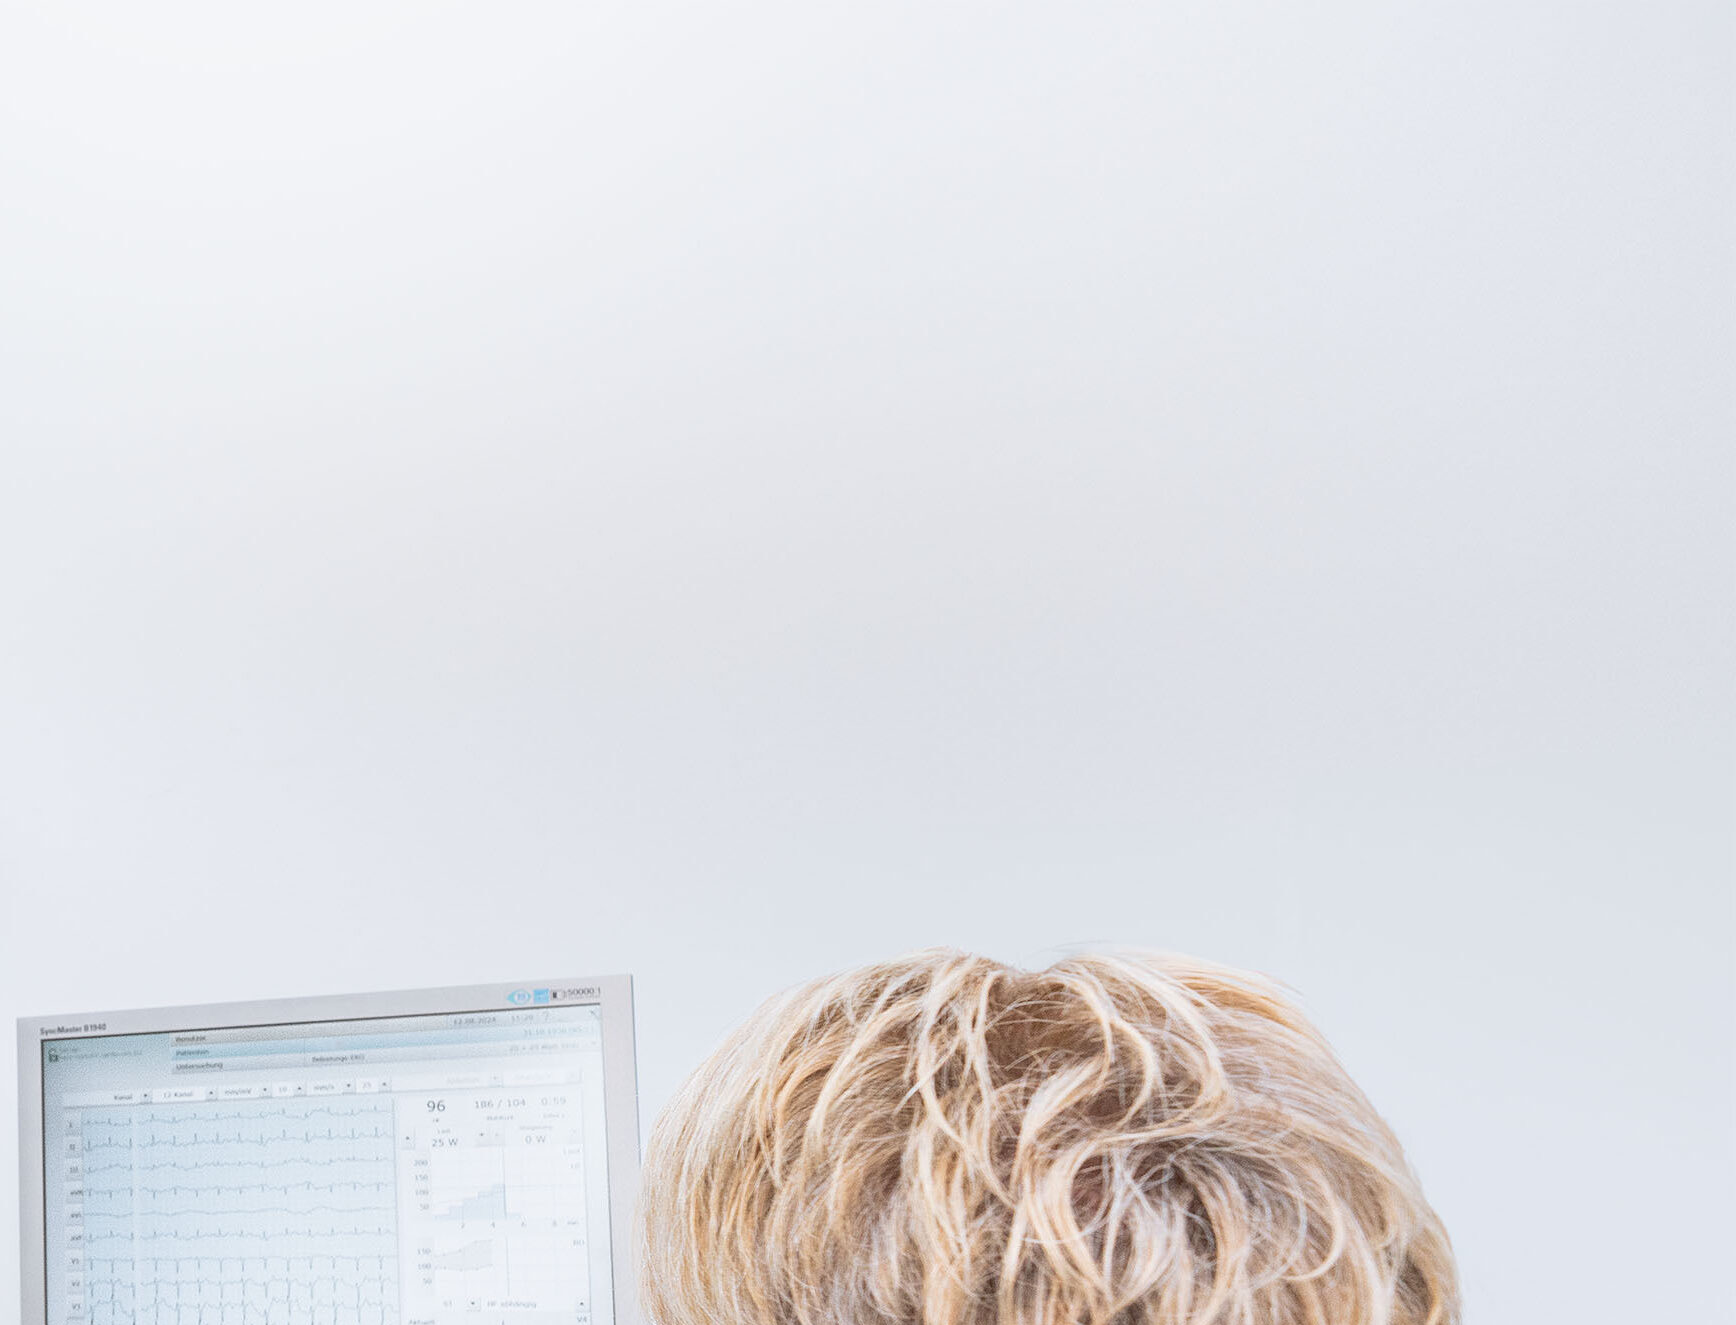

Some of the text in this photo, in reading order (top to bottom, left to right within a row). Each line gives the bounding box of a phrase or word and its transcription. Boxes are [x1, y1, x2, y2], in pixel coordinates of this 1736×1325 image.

[40, 1025, 82, 1036] SyncMaster
[175, 1061, 224, 1071] Untersuchung
[426, 1099, 446, 1113] 96
[507, 1098, 526, 1108] 104
[431, 1137, 459, 1148] 25 W
